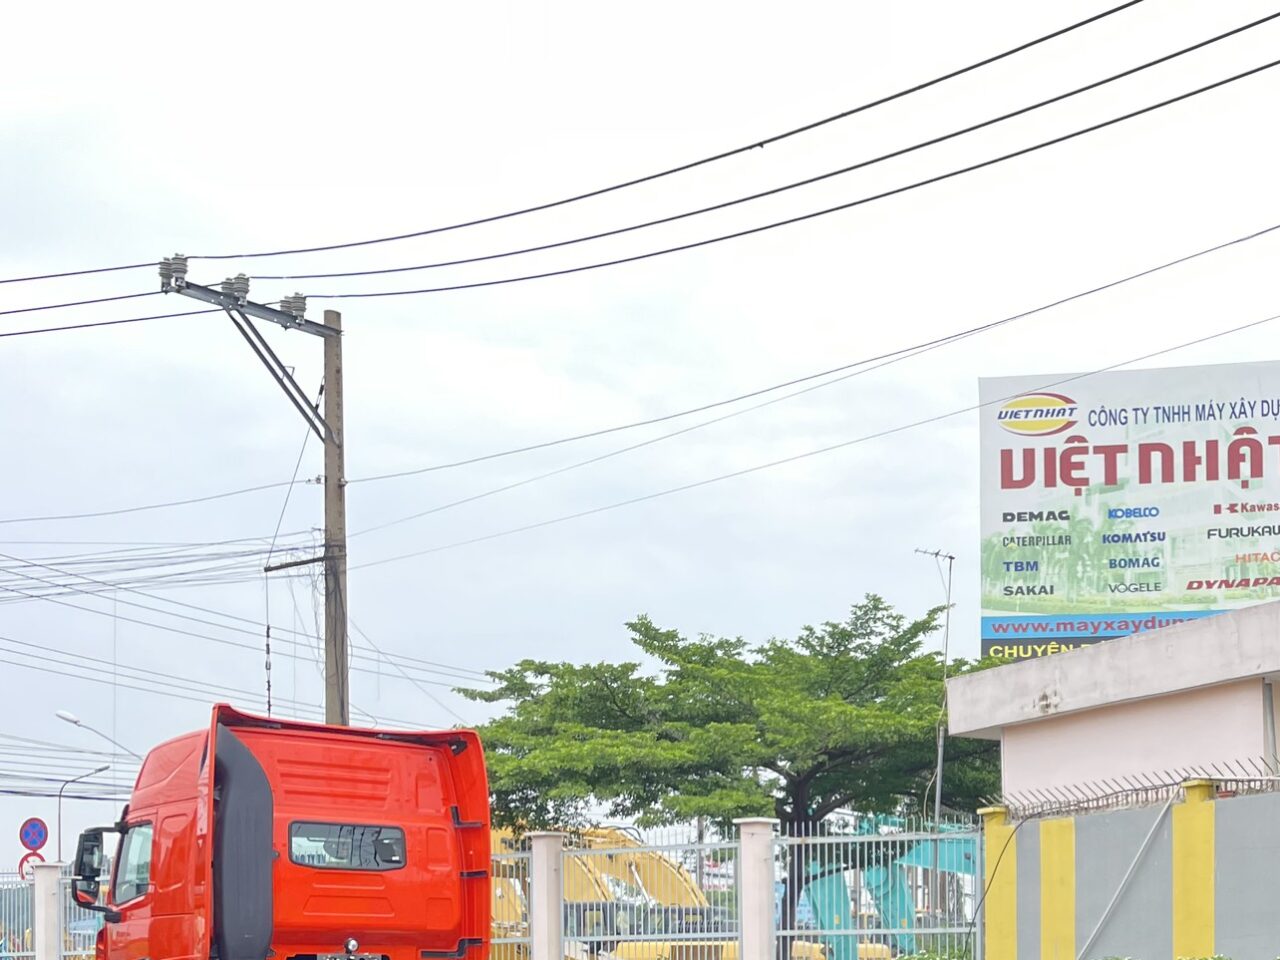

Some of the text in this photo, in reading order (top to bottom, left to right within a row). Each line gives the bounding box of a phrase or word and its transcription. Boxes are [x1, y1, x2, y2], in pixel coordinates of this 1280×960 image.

[1088, 405, 1128, 427] CÔNG
[1132, 406, 1150, 424] TY
[1153, 404, 1191, 423] TNHH
[1195, 399, 1226, 421] MÁY
[1229, 397, 1257, 419] XÂY
[1002, 510, 1070, 523] DEMAG
[1108, 506, 1160, 520] KOBELCO
[1002, 534, 1072, 548] CATERPILLAR
[1102, 530, 1166, 544] KOMATSU
[1003, 560, 1039, 572] TBM
[1109, 556, 1160, 569] BOMAG
[1003, 585, 1055, 596] SAKAI
